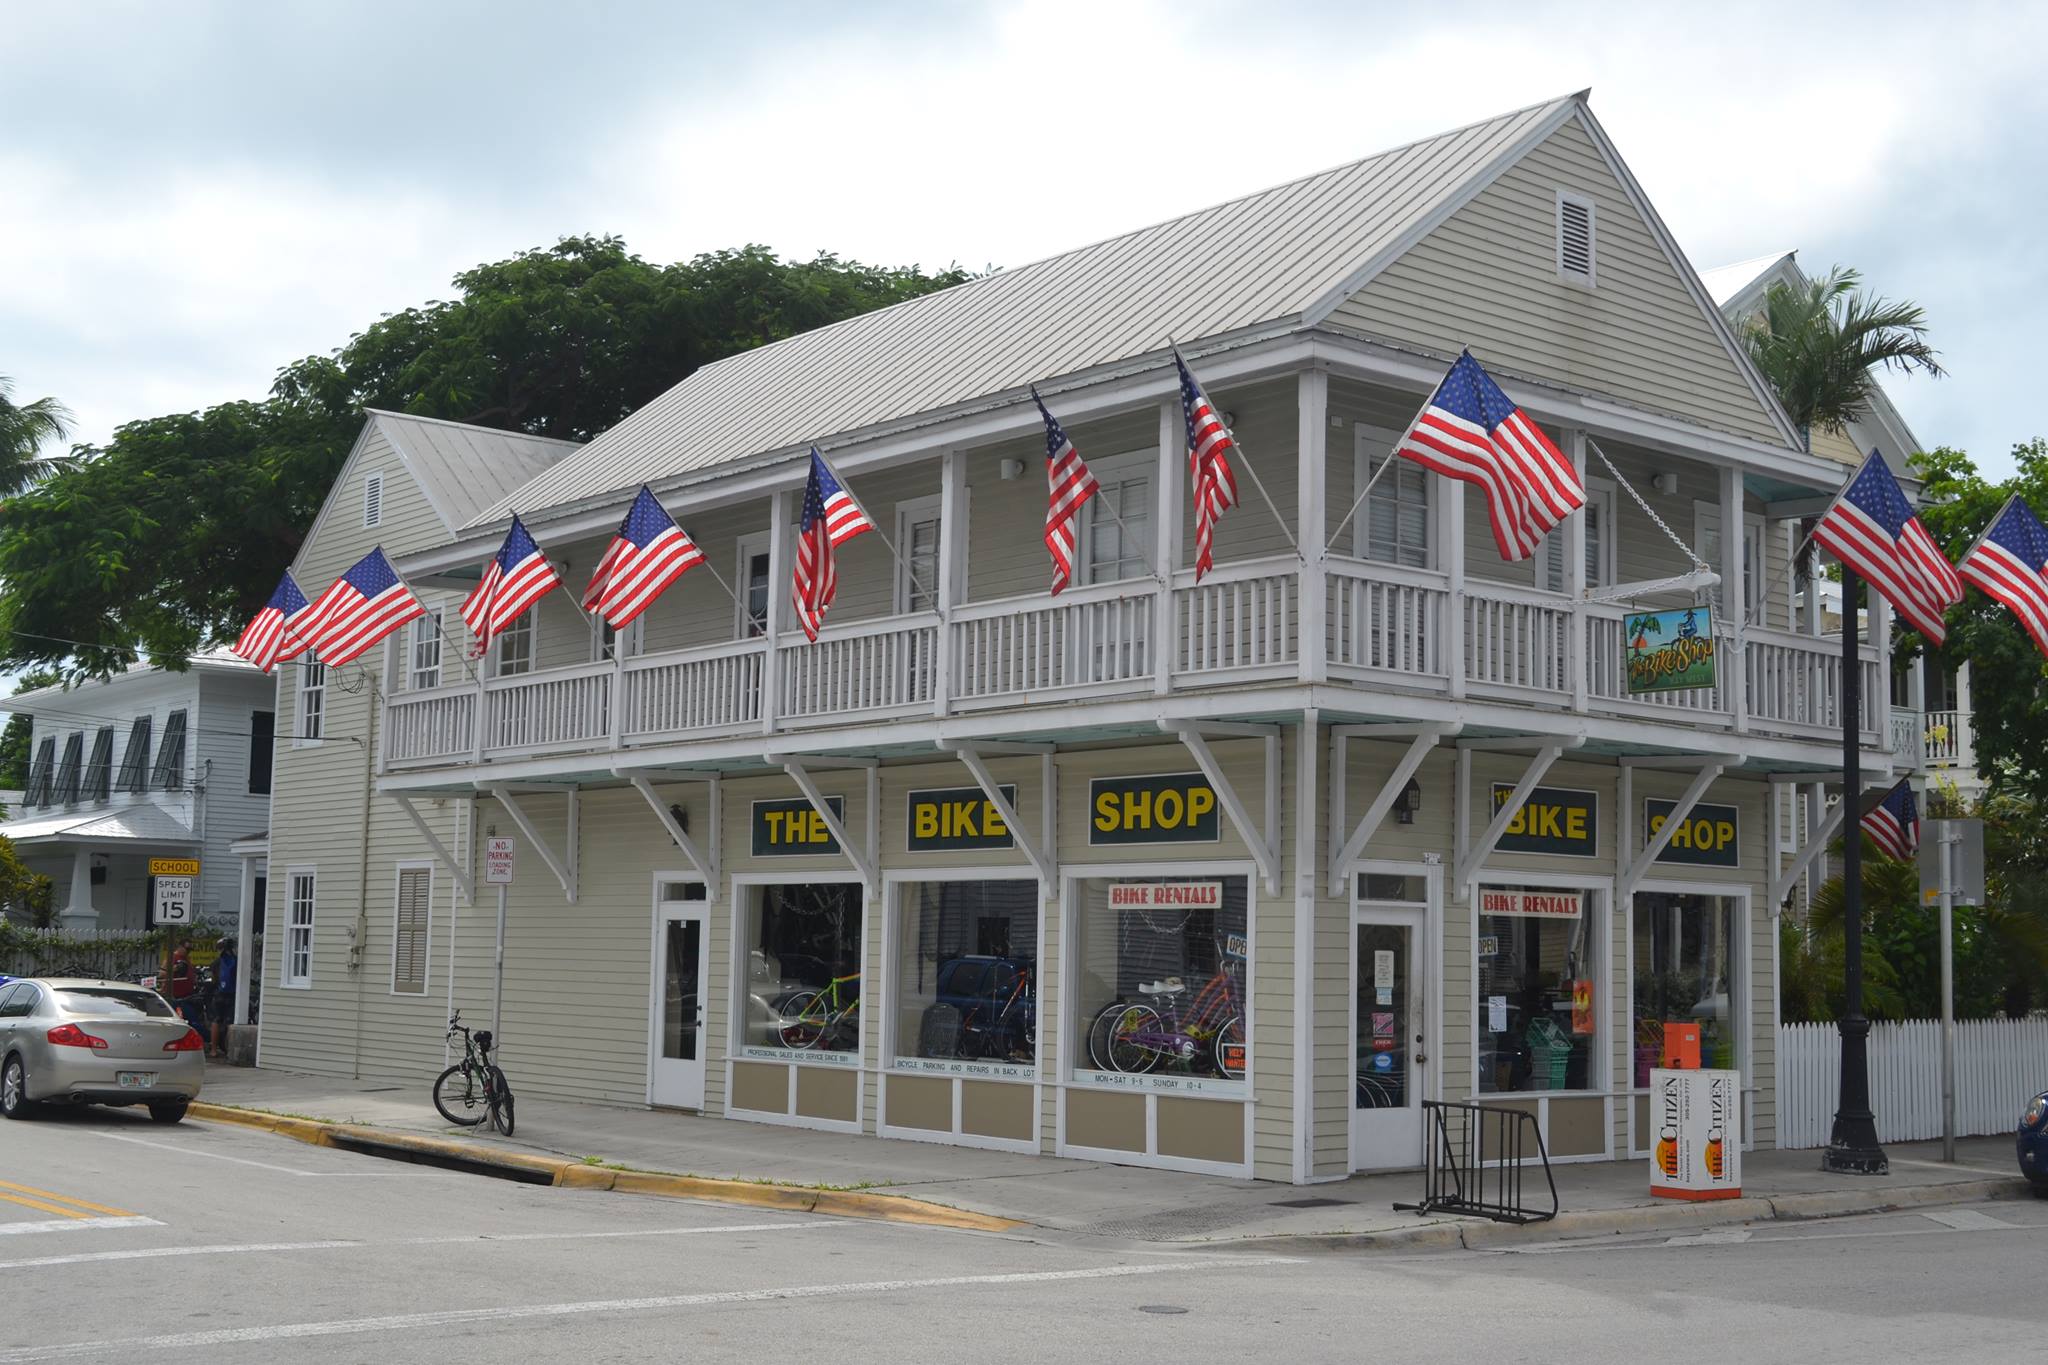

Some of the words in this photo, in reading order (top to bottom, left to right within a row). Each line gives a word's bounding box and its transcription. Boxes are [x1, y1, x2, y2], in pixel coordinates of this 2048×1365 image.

[1677, 636, 1713, 672] Shop
[1494, 789, 1514, 806] TH
[1094, 786, 1215, 832] SHOP
[764, 810, 829, 845] THE
[915, 800, 1007, 838] BIKE
[1504, 803, 1588, 840] BIKE
[495, 841, 506, 850] NO
[488, 851, 513, 861] PARKING
[153, 862, 197, 872] SCHOOL
[158, 880, 191, 889] SPEED
[161, 891, 186, 899] LIMIT
[1112, 887, 1149, 904] BIKE
[1154, 886, 1217, 904] RENTALS
[162, 902, 184, 919] 15
[1483, 894, 1517, 912] BIKE
[1522, 896, 1578, 914] RENTALS
[1229, 937, 1247, 955] OPE
[780, 1050, 792, 1058] SALES
[795, 1051, 804, 1059] AND
[1228, 1048, 1244, 1057] HELP
[897, 1060, 918, 1068] BICYCLE
[923, 1062, 945, 1070] PARKING
[967, 1065, 989, 1073] REPAIRS
[1024, 1069, 1035, 1077] LOT
[1225, 1058, 1246, 1069] WANTE
[1153, 1079, 1178, 1088] SUNDAY
[1660, 1077, 1678, 1143] CITIZEN
[1707, 1078, 1723, 1144] CITIZEN
[1665, 1151, 1678, 1182] THE
[1712, 1151, 1723, 1183] THE
